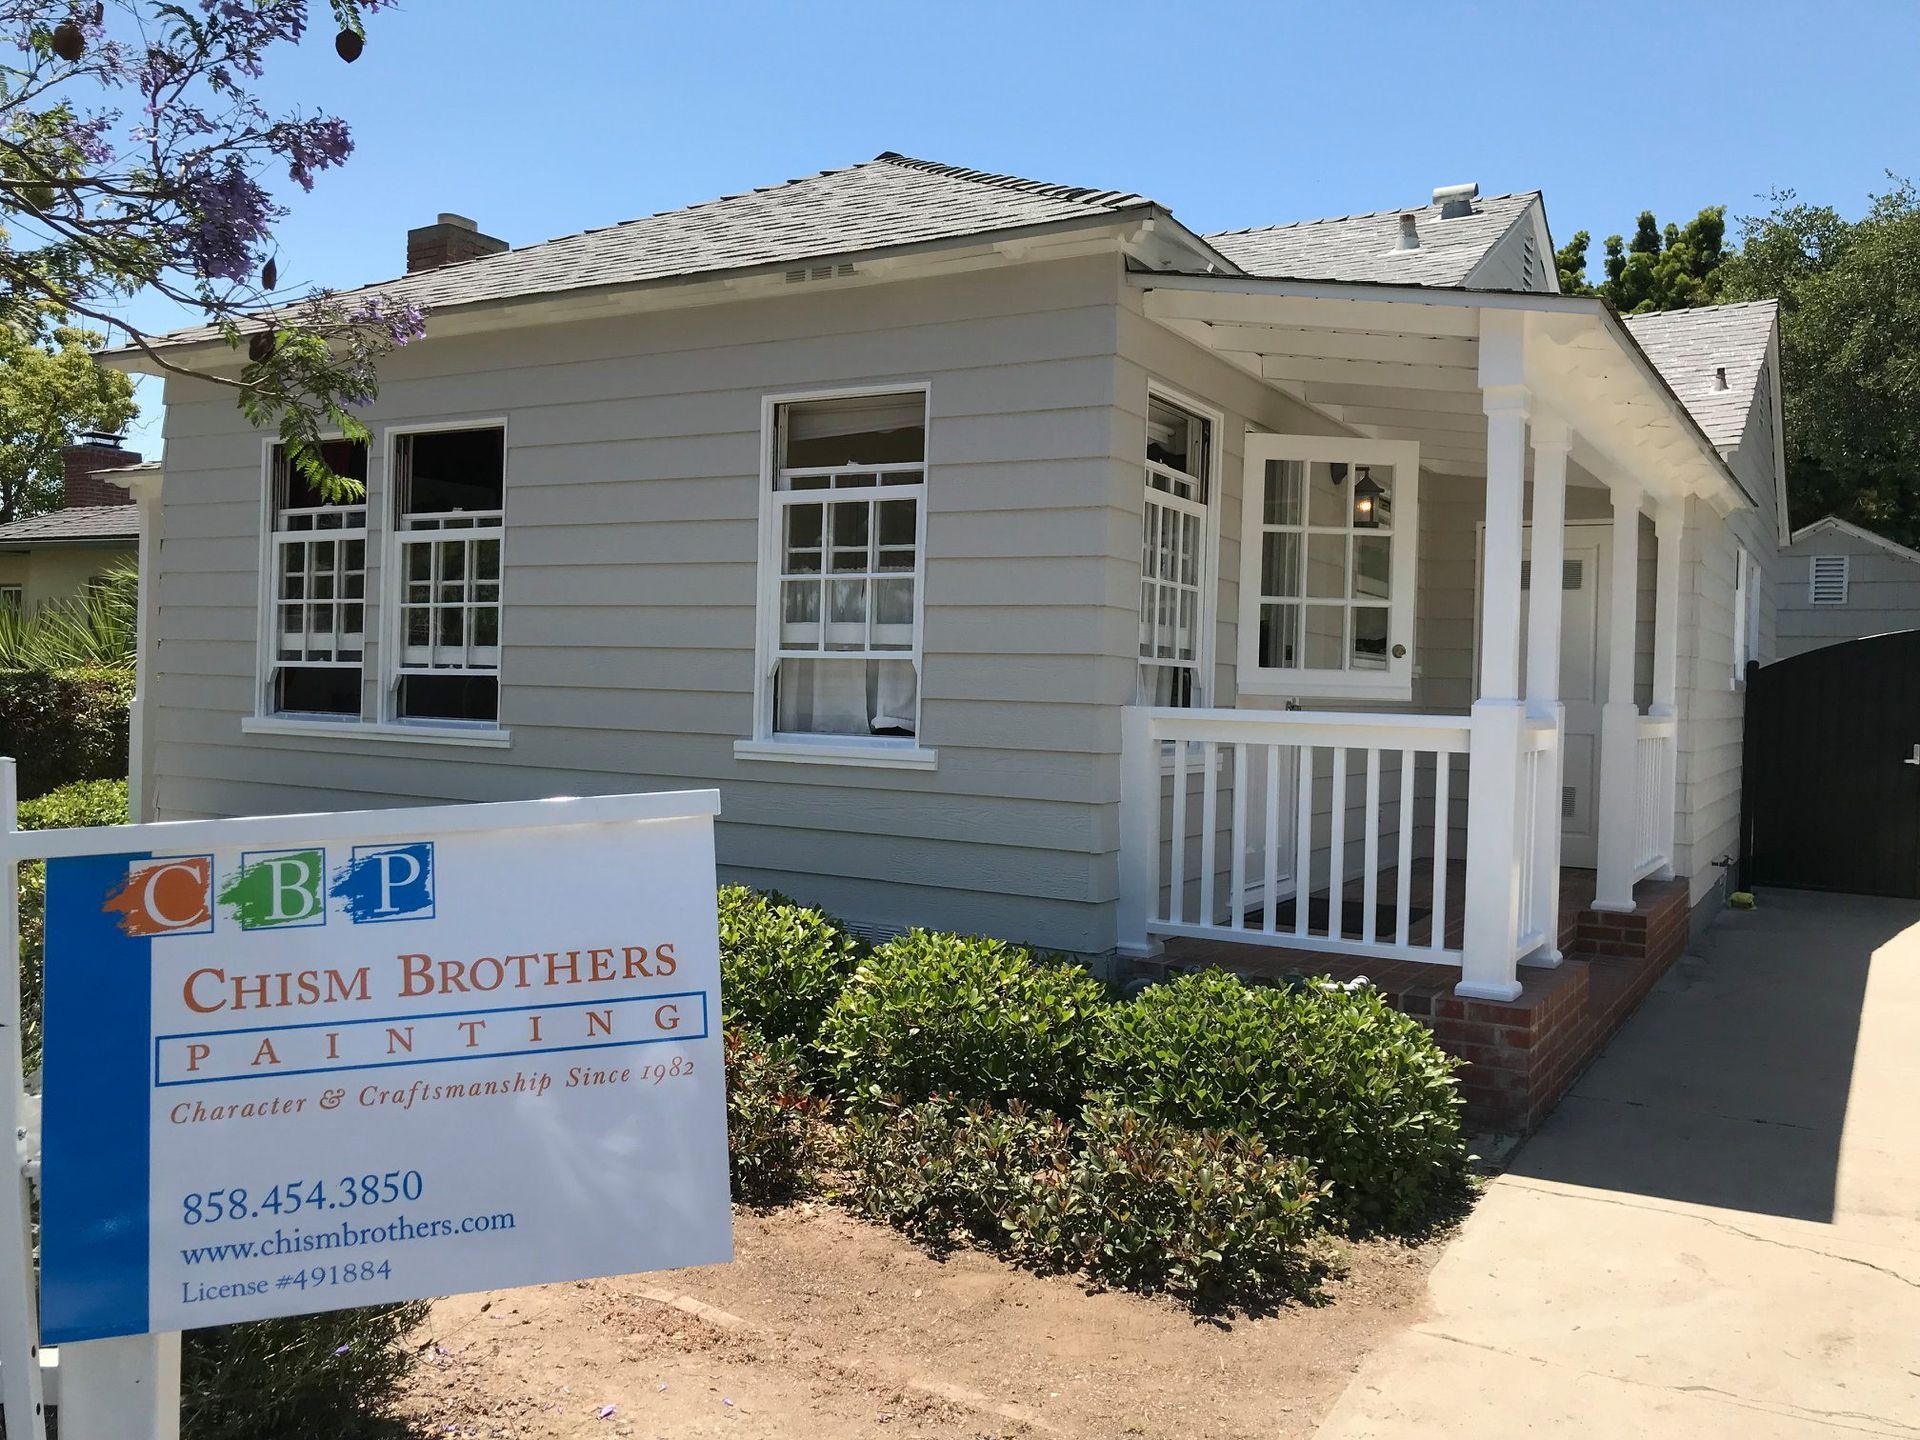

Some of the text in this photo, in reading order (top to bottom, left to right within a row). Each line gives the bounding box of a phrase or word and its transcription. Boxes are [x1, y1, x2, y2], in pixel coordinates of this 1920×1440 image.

[183, 943, 677, 1014] CHISM BROTHERS
[187, 1004, 680, 1071] PAINTING
[170, 1057, 696, 1125] Character & Craftsmanship Since 1982
[183, 1170, 423, 1226] 858.454.3850
[181, 1209, 517, 1265] www.chismbrothers.com
[182, 1259, 392, 1303] License #491884
